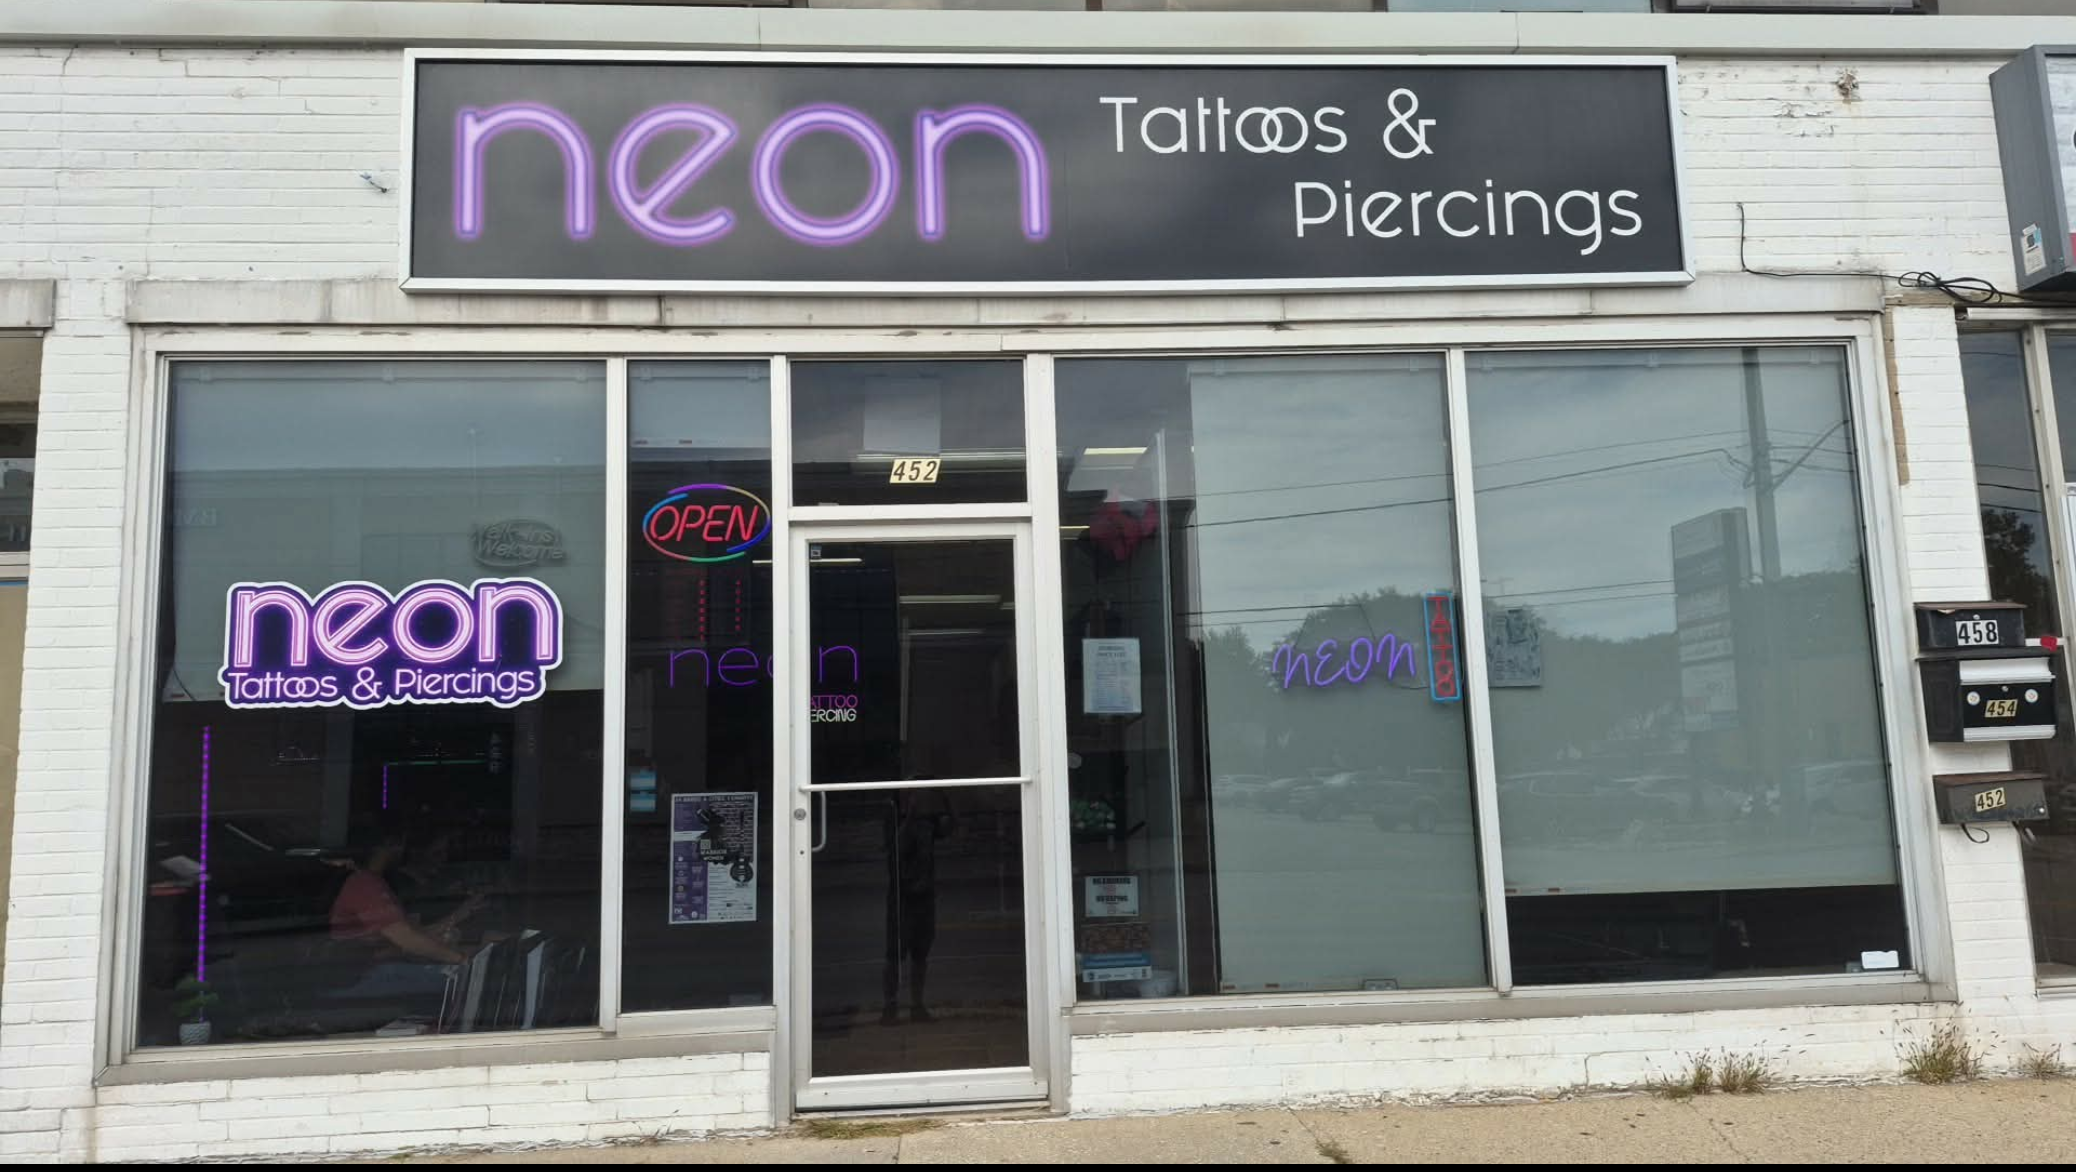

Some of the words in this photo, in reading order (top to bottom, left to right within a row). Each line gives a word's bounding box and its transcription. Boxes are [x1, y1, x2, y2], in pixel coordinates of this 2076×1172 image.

[1099, 95, 1349, 154] Tattoos
[1382, 87, 1437, 160] &
[454, 101, 1051, 246] neon
[1294, 179, 1643, 256] Piercings
[892, 460, 939, 482] 452
[649, 504, 761, 543] OPEN
[233, 585, 555, 668] neon
[1957, 621, 1998, 645] 458
[1427, 595, 1457, 698] TATTOO
[228, 672, 338, 701] Tattoos
[352, 666, 383, 701] &
[394, 667, 535, 701] Piercings
[668, 644, 861, 689] nen
[810, 694, 859, 708] ATTOO
[810, 708, 858, 723] ERCING
[1985, 700, 2017, 717] 454
[1976, 789, 2005, 811] 452
